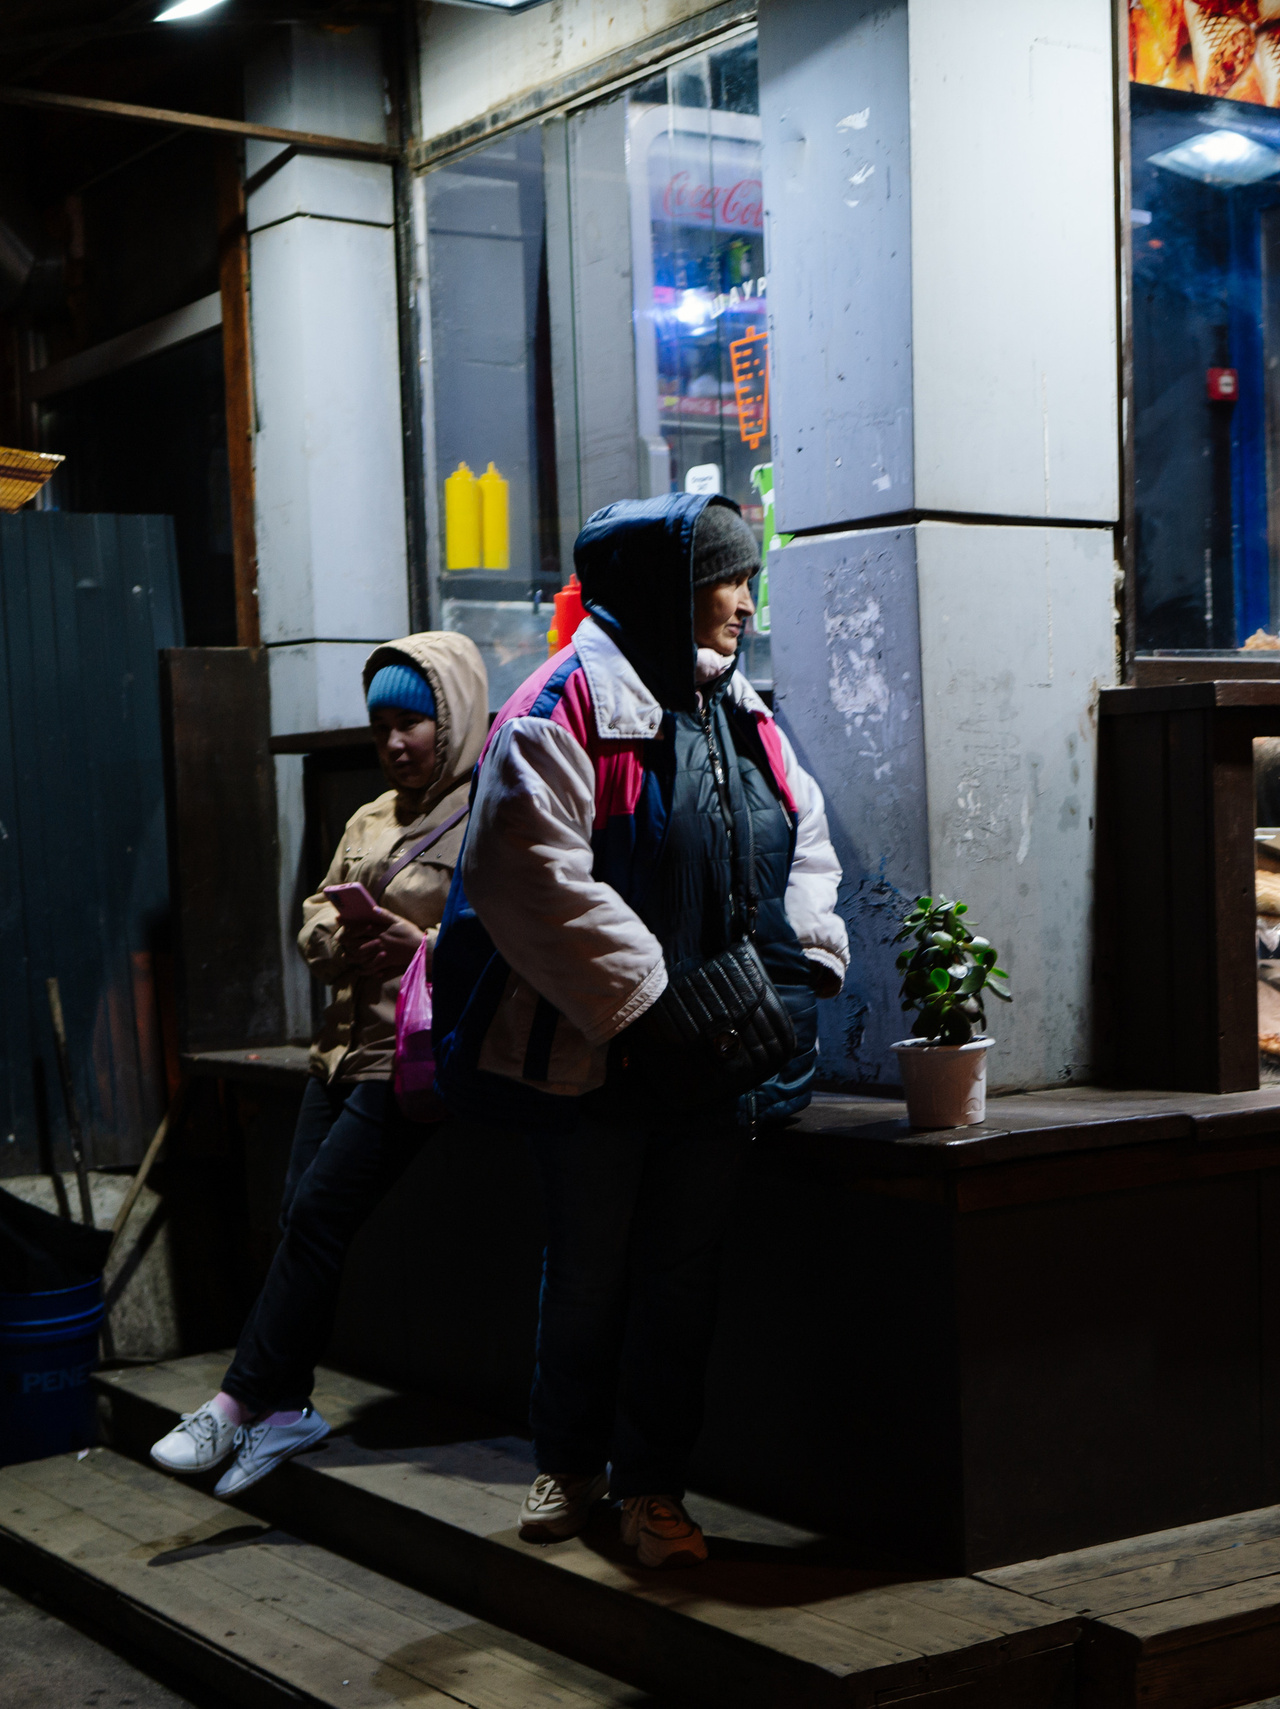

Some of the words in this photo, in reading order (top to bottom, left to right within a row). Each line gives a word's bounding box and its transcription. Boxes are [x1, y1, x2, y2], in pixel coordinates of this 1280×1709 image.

[662, 170, 763, 227] Coca-Col
[710, 276, 768, 320] ШАУР
[23, 1363, 90, 1394] PENE
